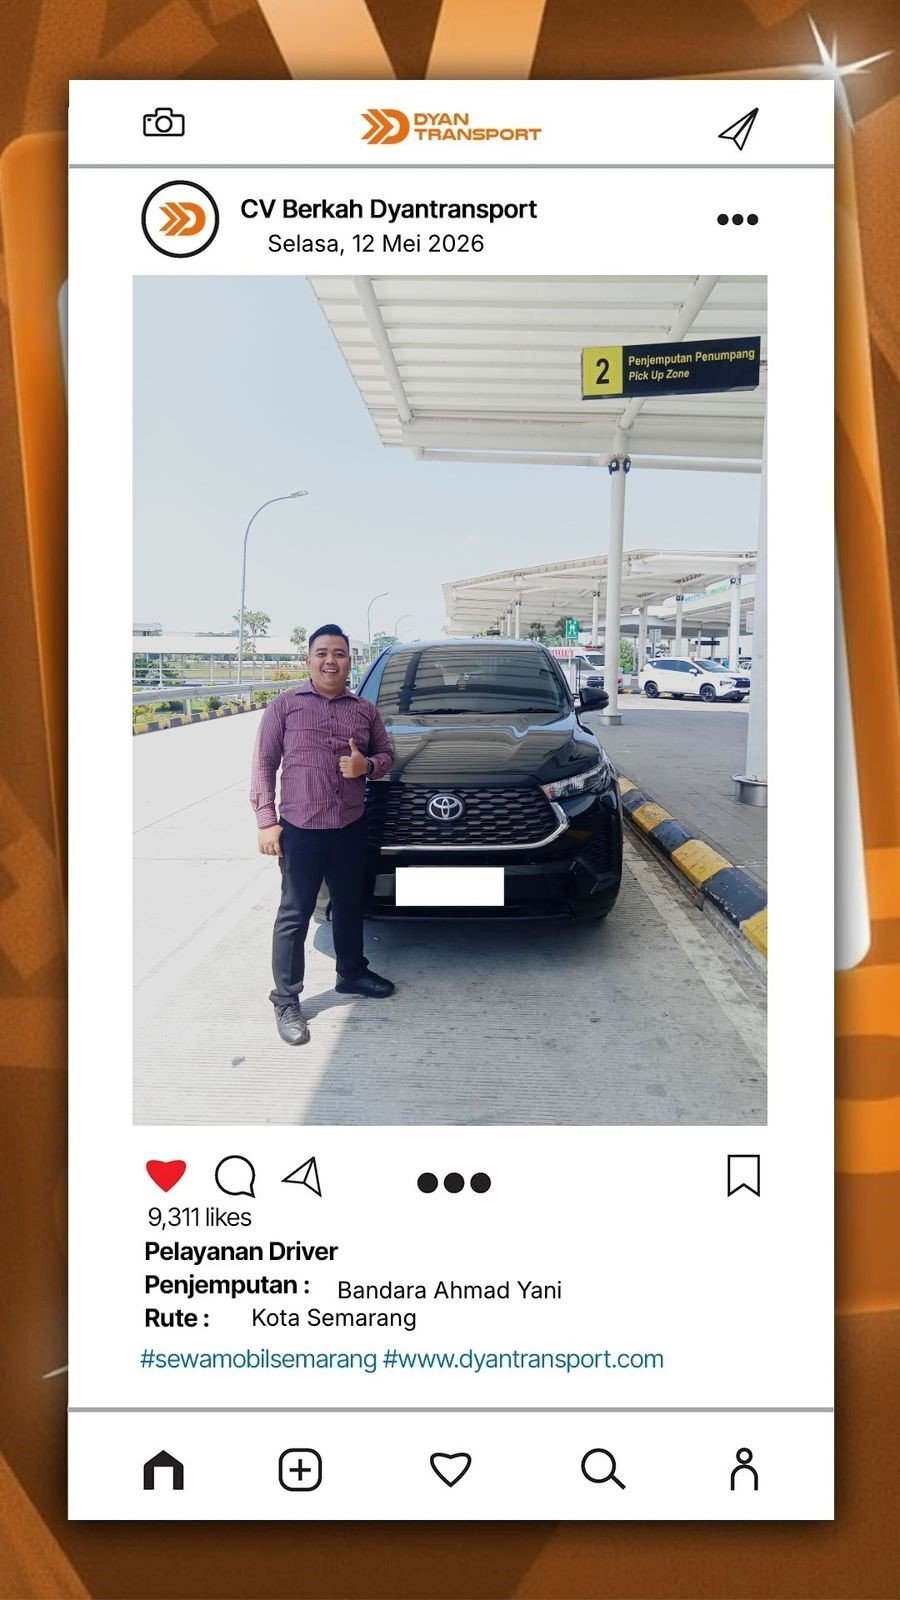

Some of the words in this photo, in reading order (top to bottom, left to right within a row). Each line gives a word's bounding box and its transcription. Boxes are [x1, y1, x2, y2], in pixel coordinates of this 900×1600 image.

[628, 353, 692, 367] Penjemputan
[695, 350, 755, 362] Penumpang
[595, 358, 610, 385] 2
[628, 369, 648, 381] Pick
[651, 370, 664, 382] Up
[666, 370, 690, 380] Zone
